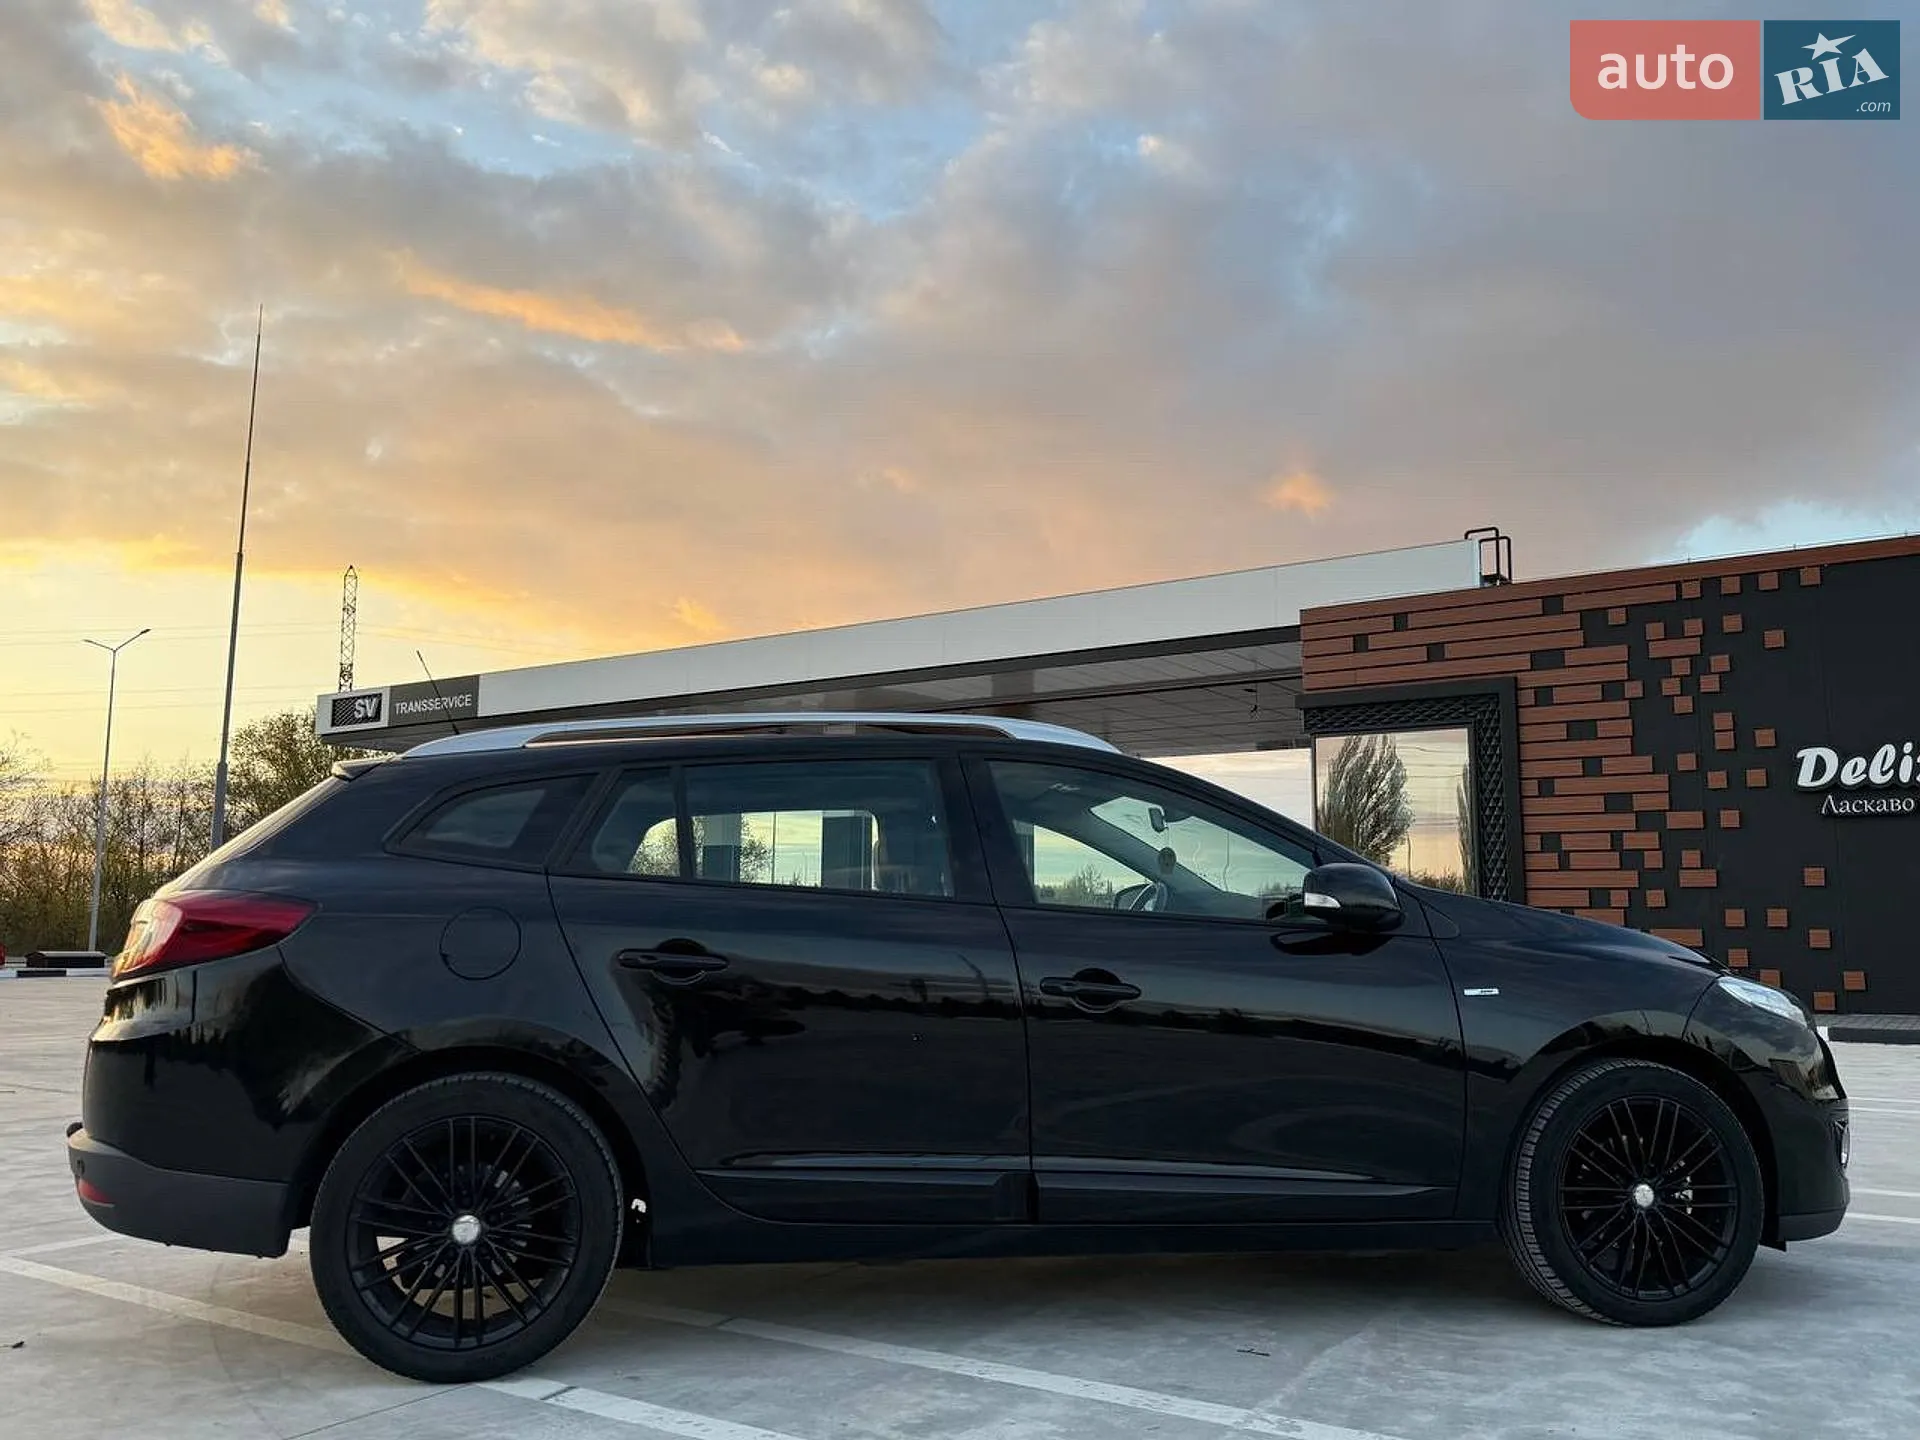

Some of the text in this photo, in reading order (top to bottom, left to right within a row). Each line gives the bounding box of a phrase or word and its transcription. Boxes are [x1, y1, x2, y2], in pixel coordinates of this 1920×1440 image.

[354, 698, 378, 719] SV
[394, 694, 473, 715] TRANSSERVICE
[1796, 742, 1920, 787] Deli
[1821, 795, 1915, 814] Ласкаво
